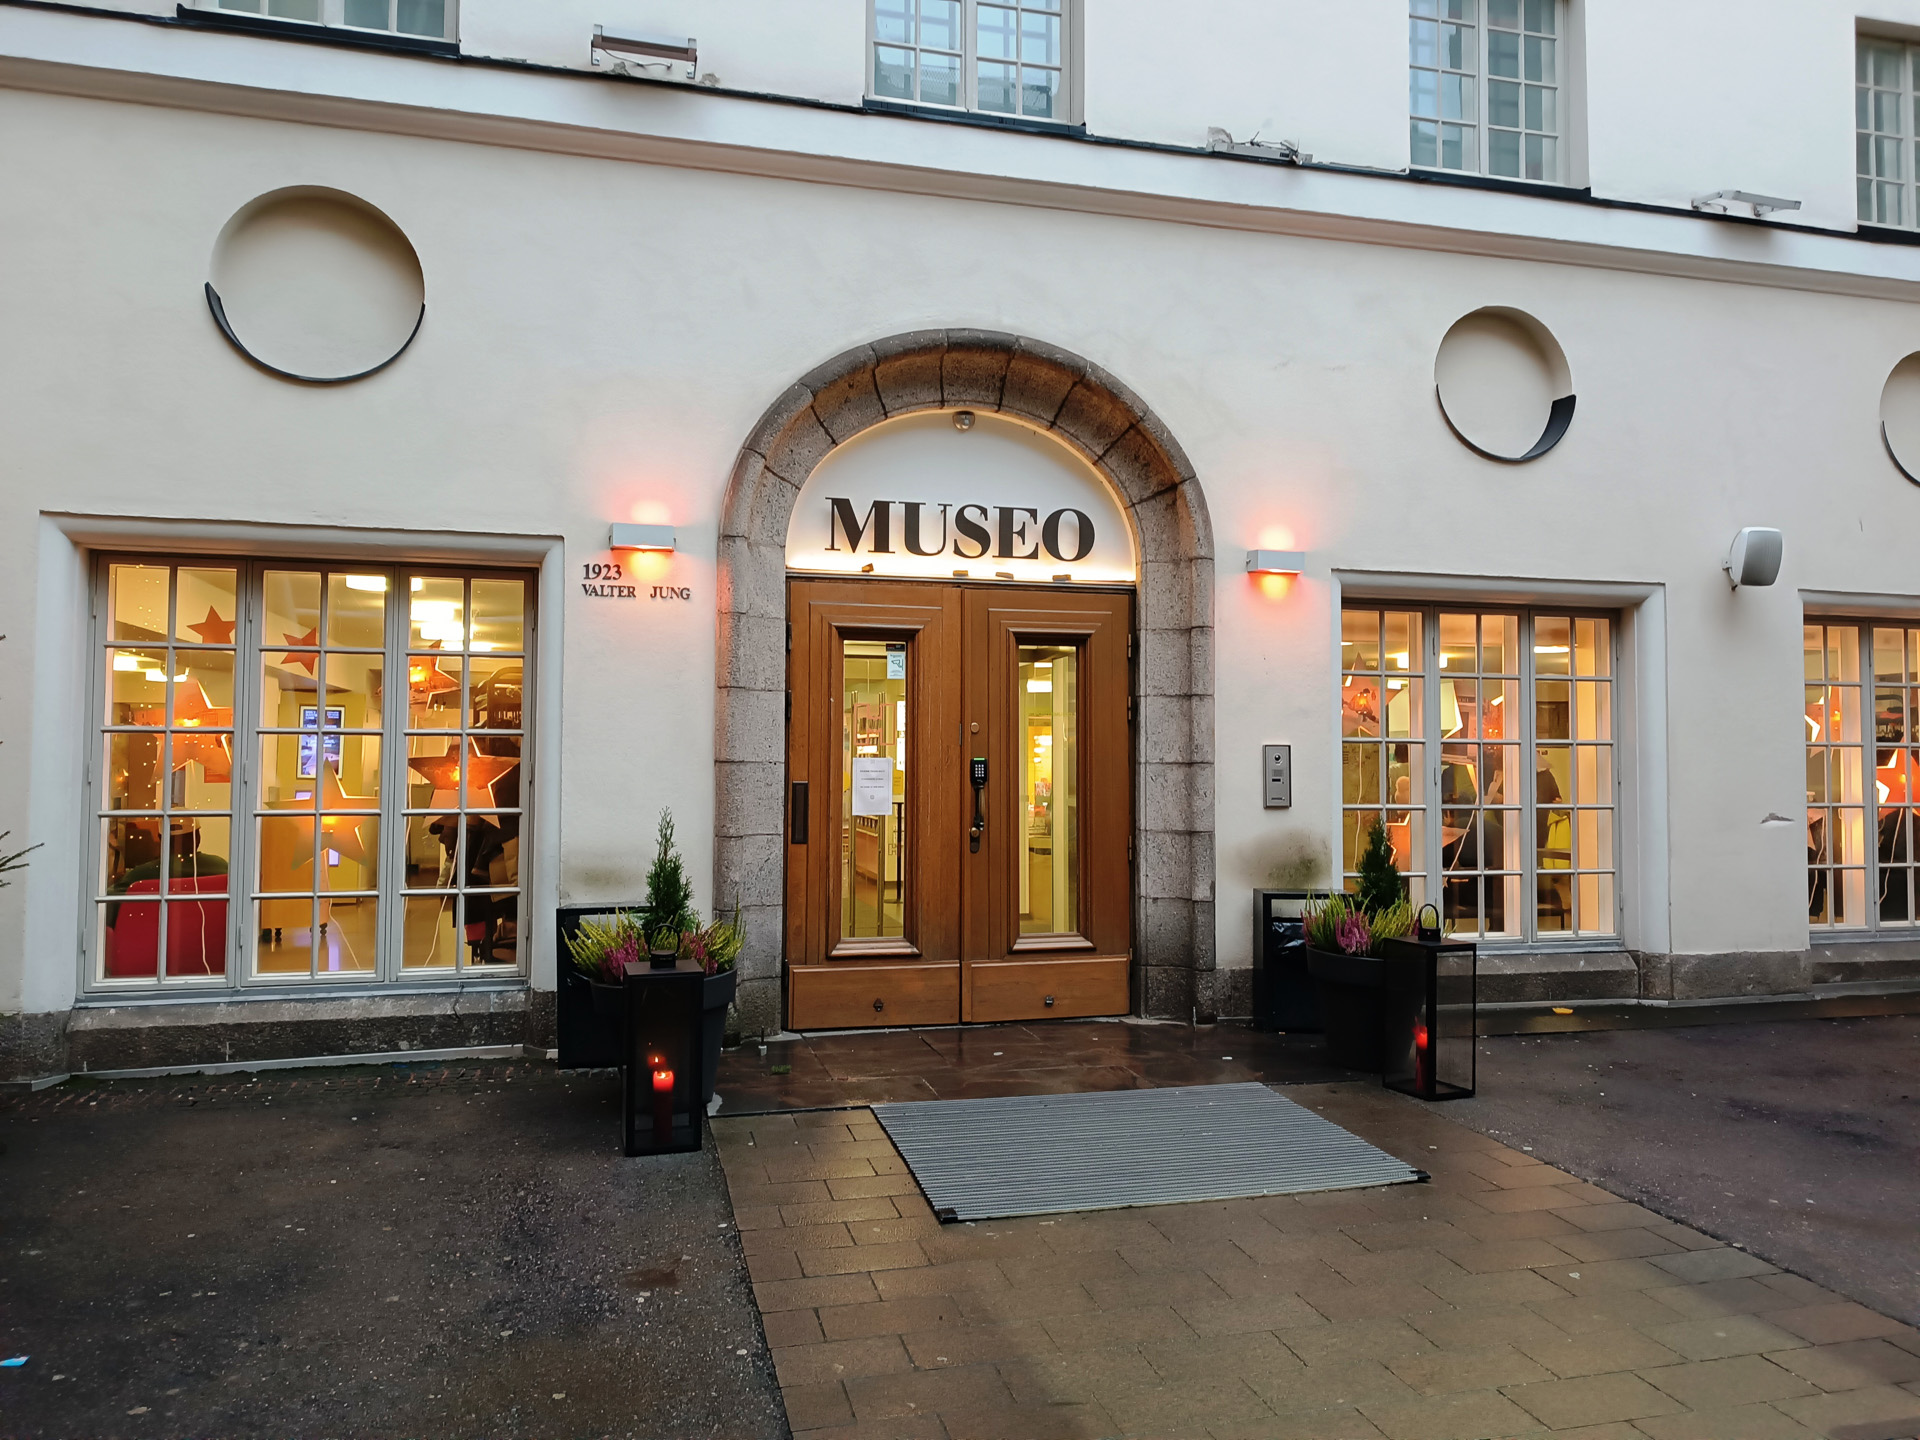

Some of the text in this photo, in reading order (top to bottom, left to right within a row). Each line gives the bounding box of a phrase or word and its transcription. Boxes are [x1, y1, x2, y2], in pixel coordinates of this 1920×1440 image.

[824, 496, 1096, 562] MUSEO
[582, 563, 623, 581] 1923
[581, 583, 691, 600] VALTER JUNG
